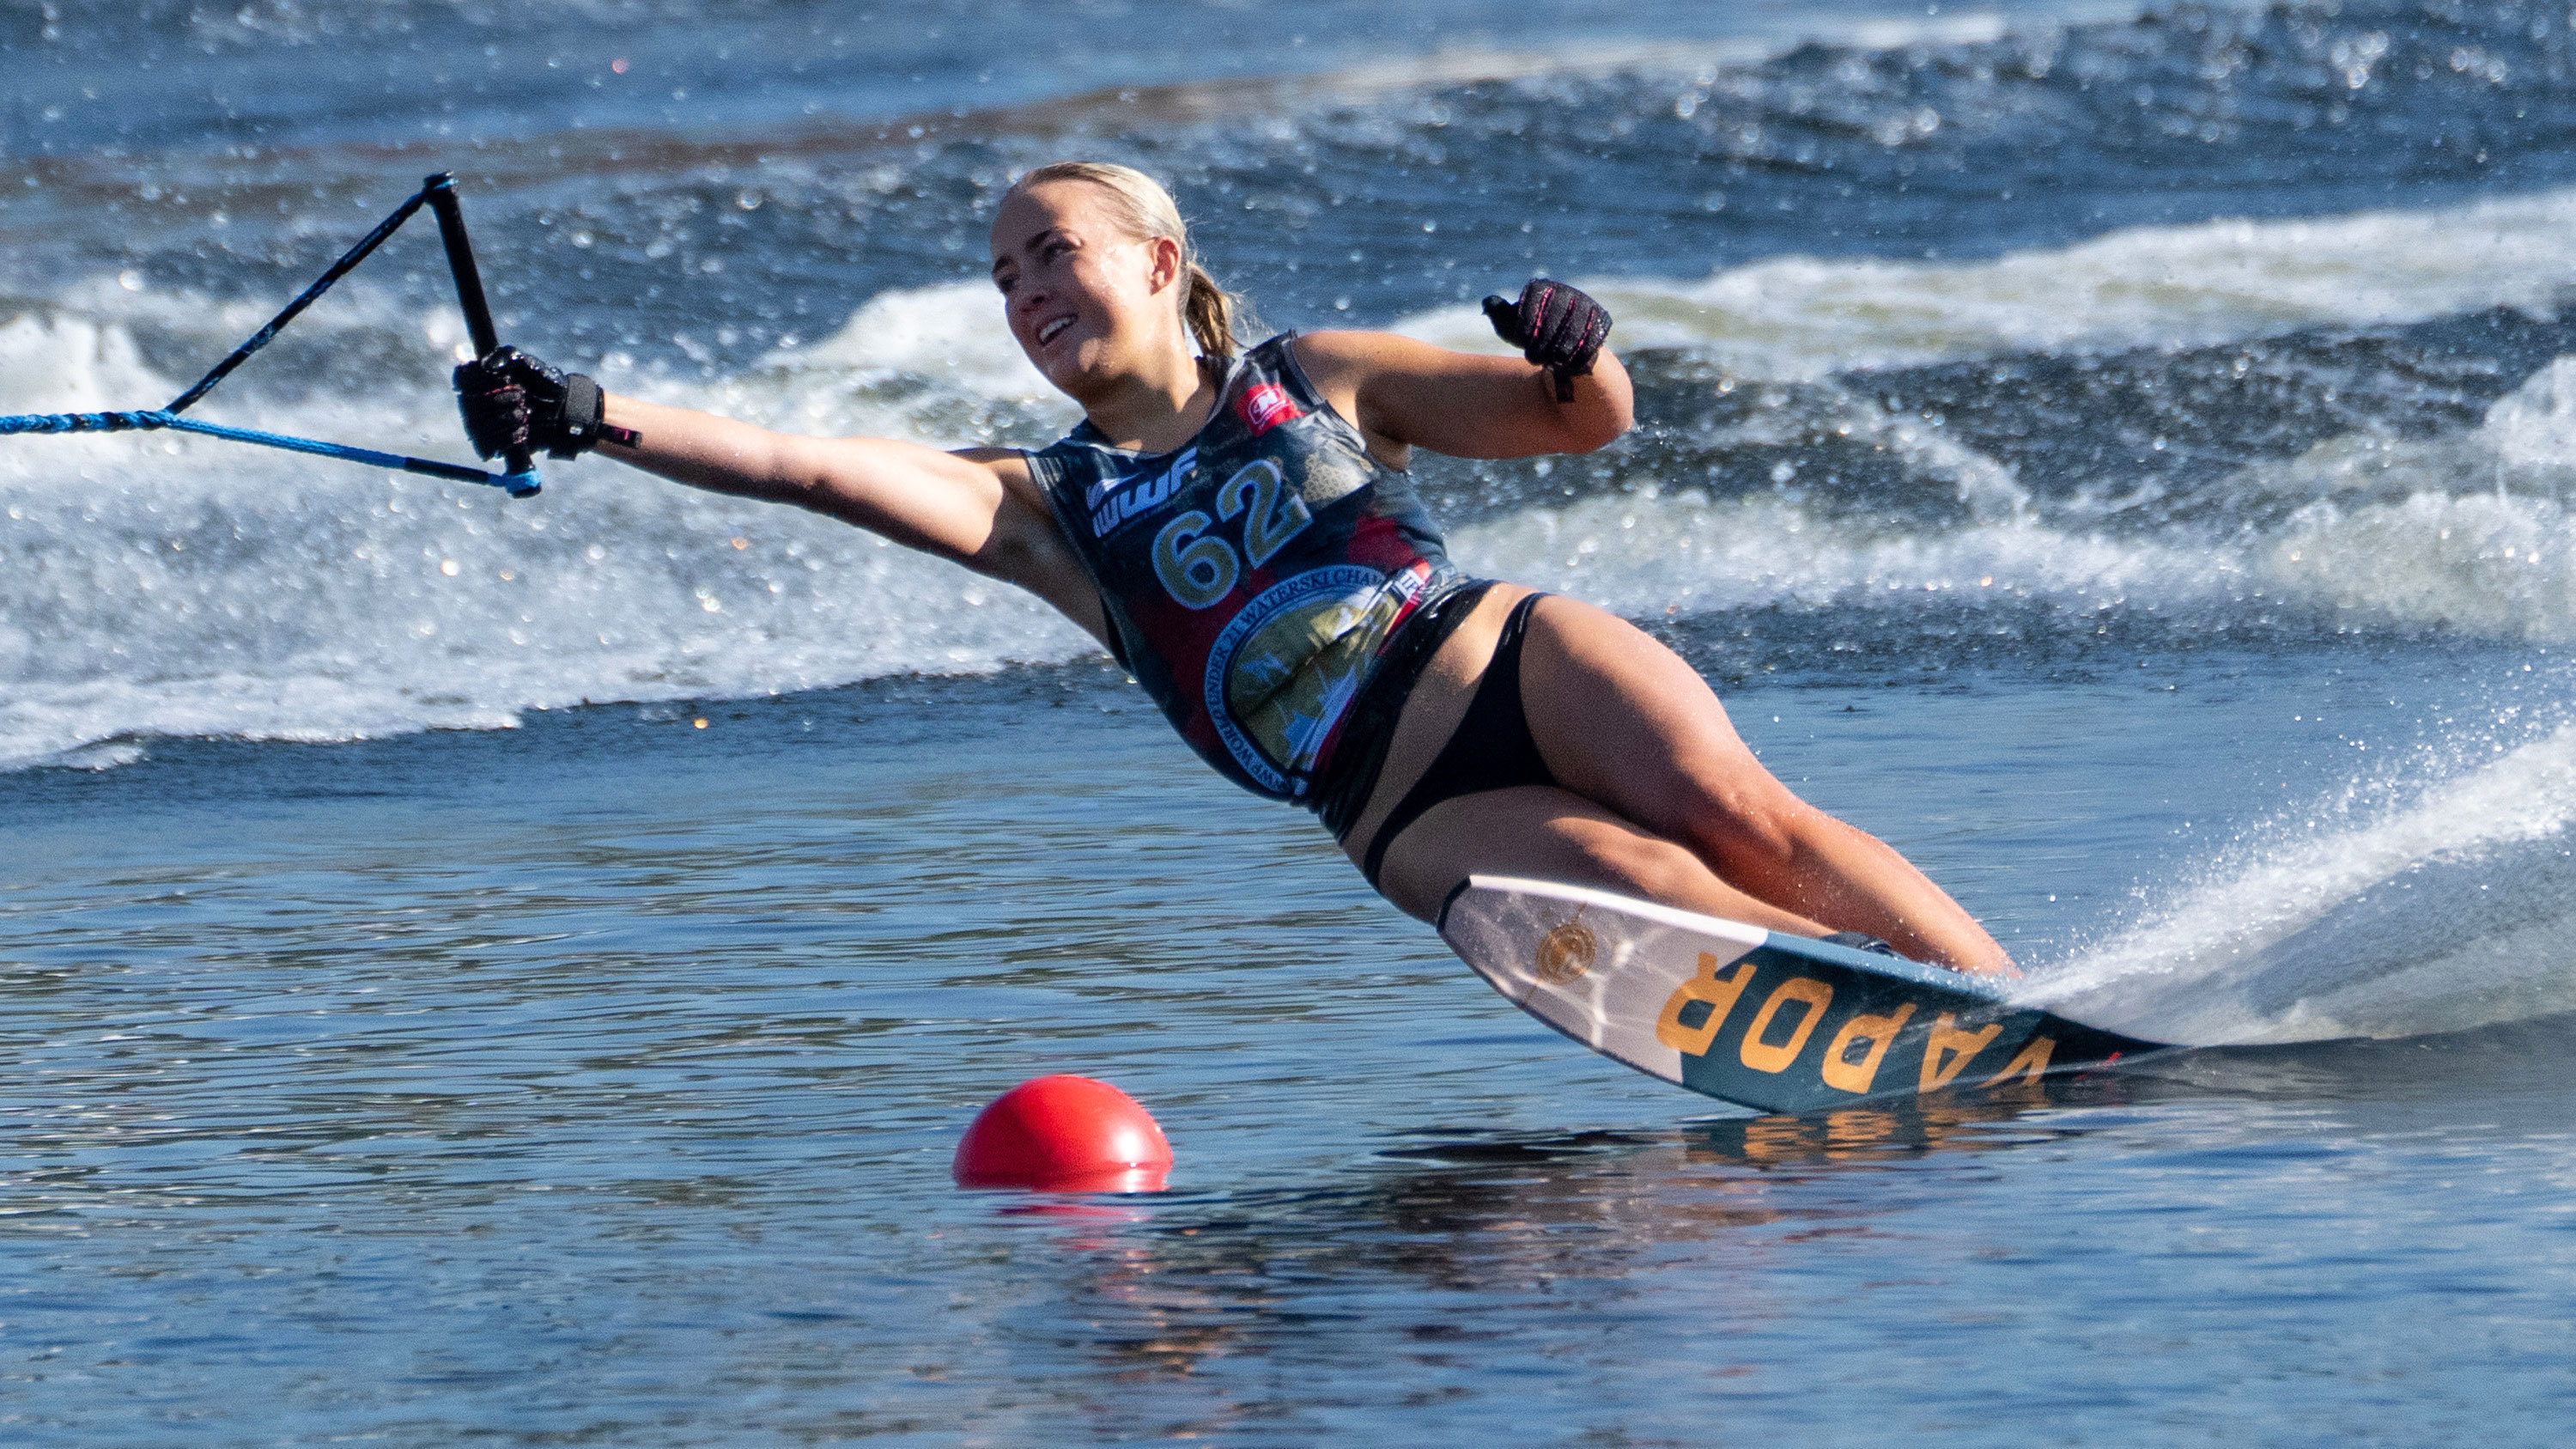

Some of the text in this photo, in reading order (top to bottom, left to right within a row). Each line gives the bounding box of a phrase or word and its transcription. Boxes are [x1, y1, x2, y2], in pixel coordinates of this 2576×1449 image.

[1151, 459, 1313, 611] 62
[1206, 643, 1228, 704] UNDER
[1222, 624, 1242, 646] 21
[1238, 571, 1327, 625] WATERSKI
[1656, 952, 2057, 1093] VAPOR
